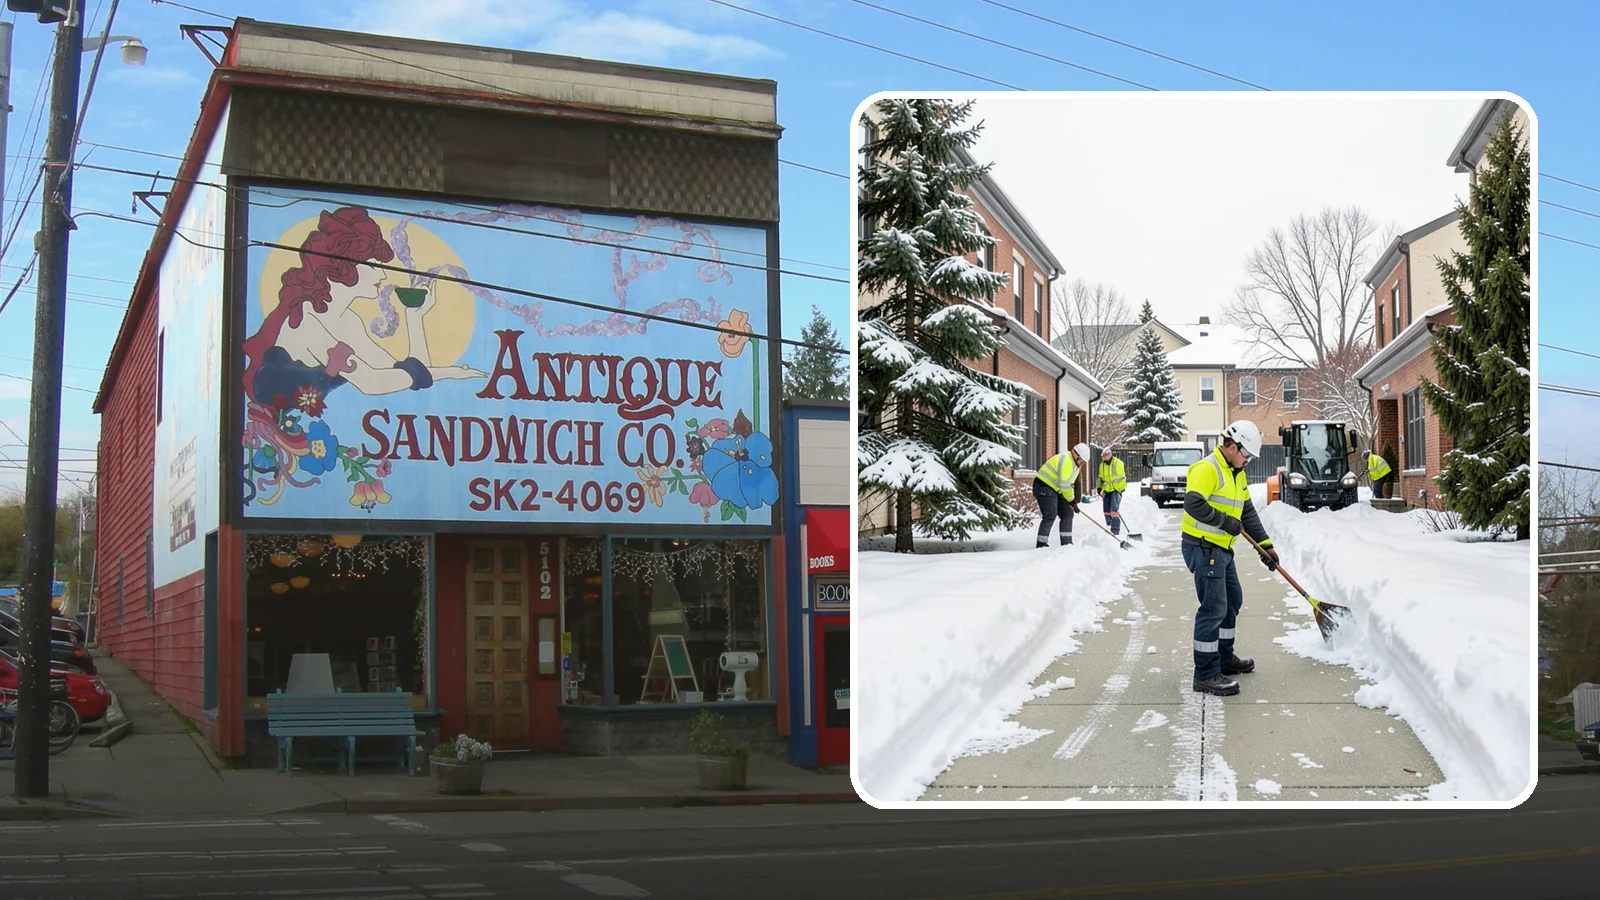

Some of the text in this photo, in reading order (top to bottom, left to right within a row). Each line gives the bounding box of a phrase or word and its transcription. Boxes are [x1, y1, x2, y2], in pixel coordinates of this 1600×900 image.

[476, 329, 723, 420] ANTIQUE
[362, 409, 685, 468] SANDWICH CO.
[468, 478, 646, 513] SK2-4069
[540, 542, 551, 599] 5102
[810, 556, 834, 568] BOOKS
